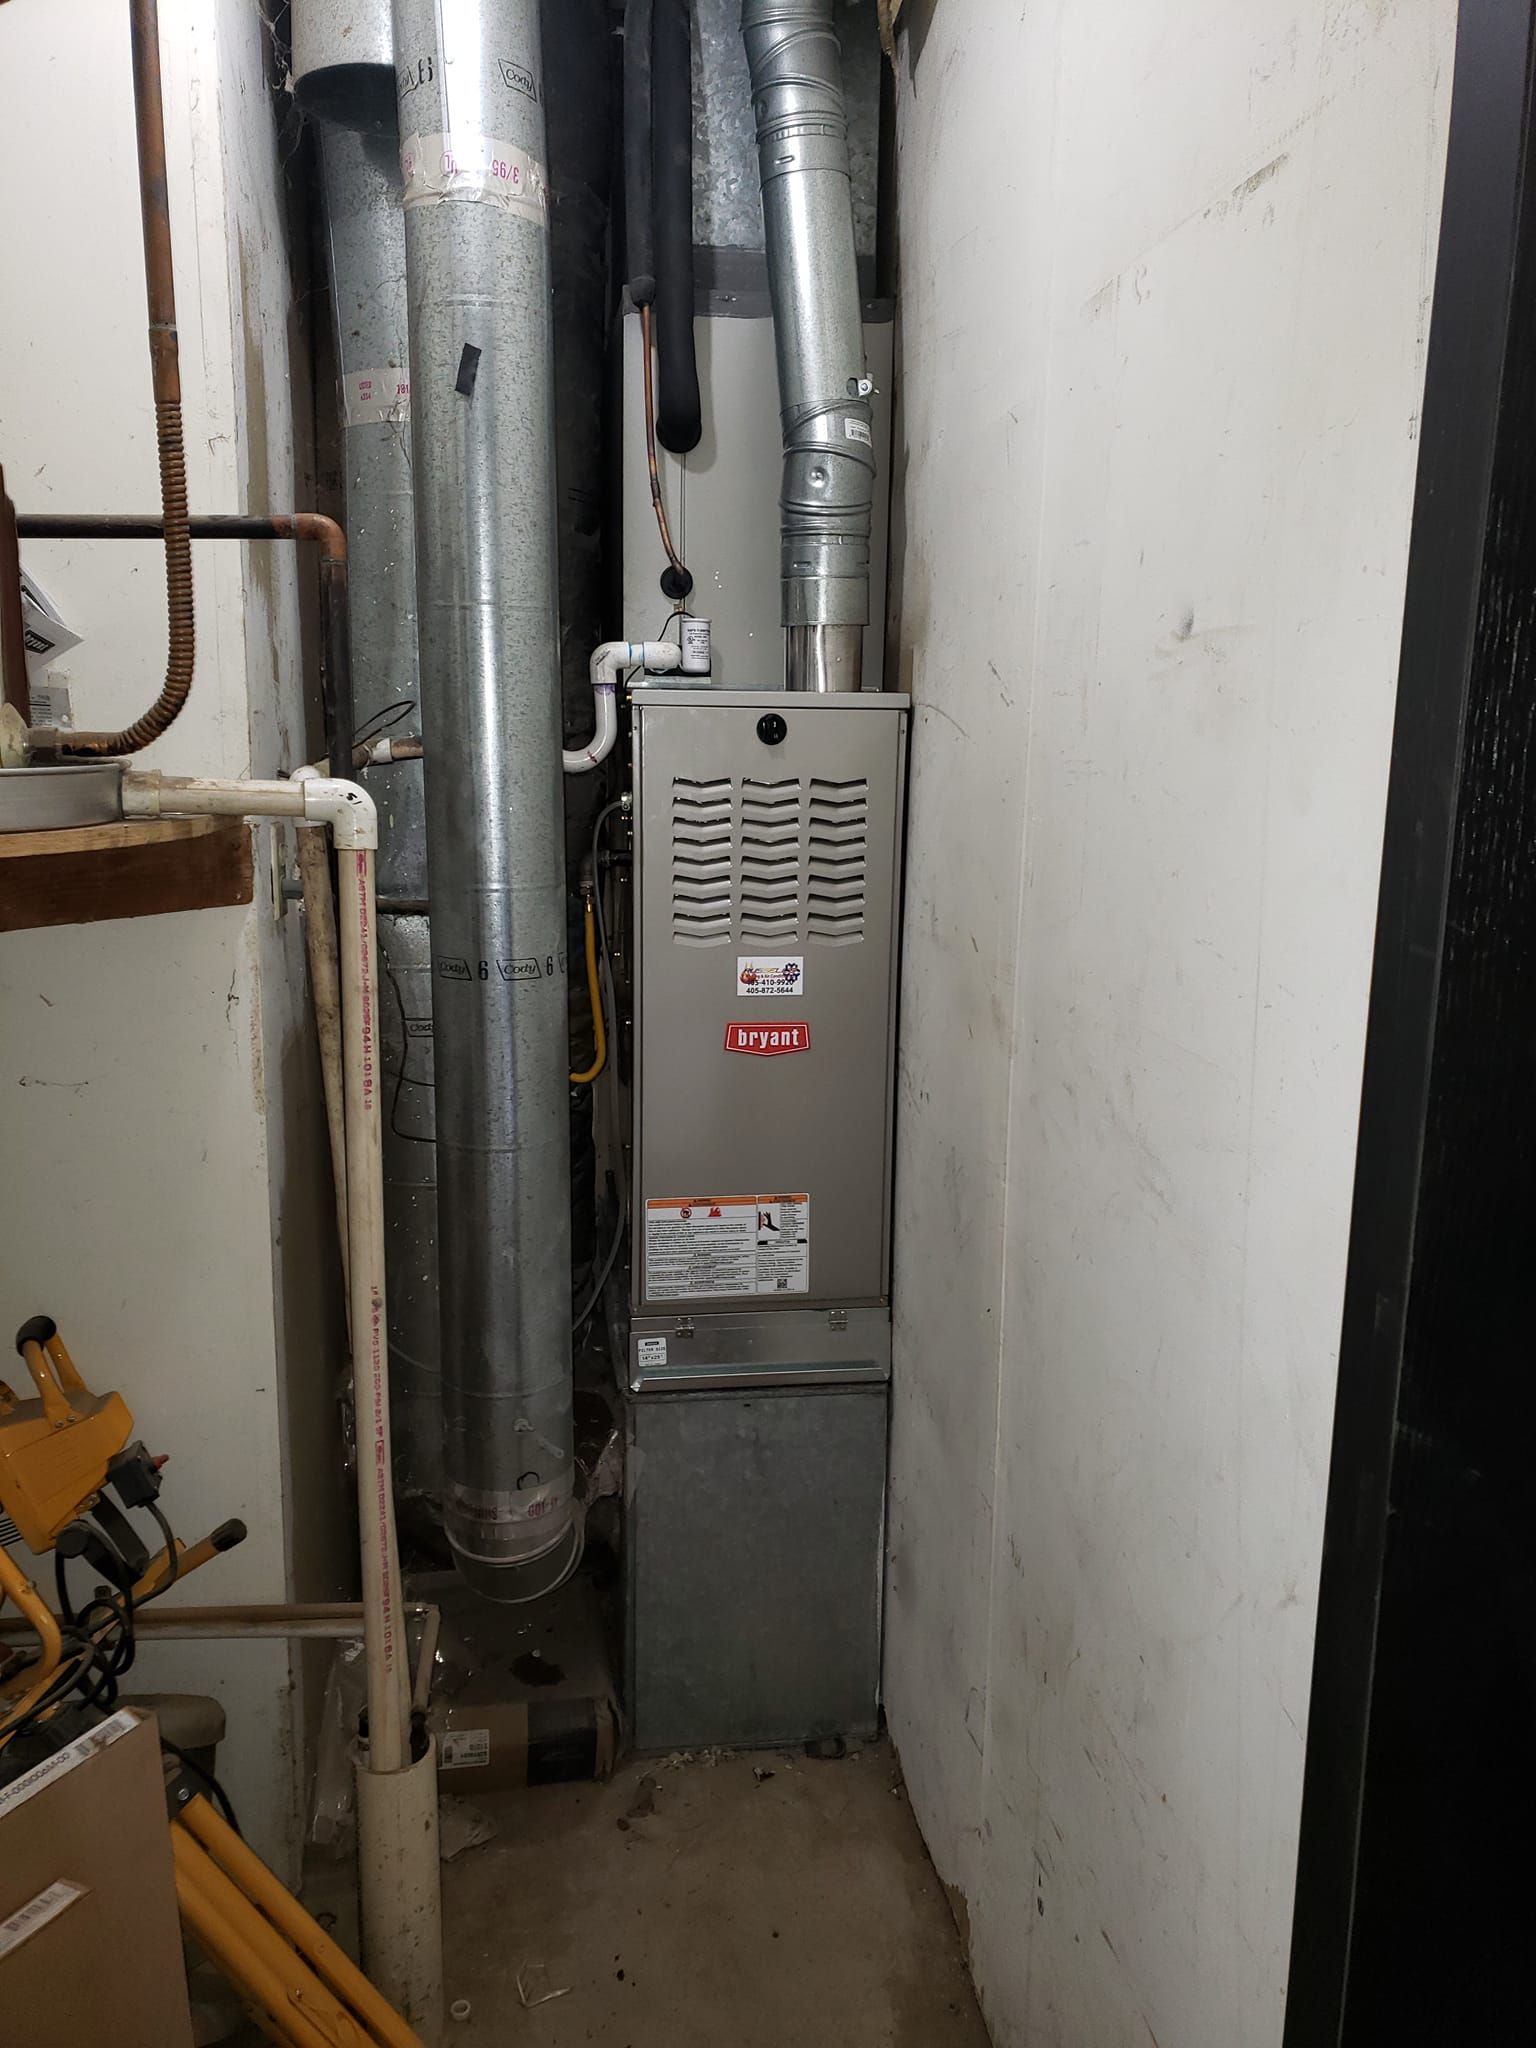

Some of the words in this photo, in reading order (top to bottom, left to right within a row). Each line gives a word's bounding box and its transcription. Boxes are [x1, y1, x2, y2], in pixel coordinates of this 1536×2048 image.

[478, 960, 489, 981] 6
[503, 963, 537, 975] Cody
[546, 955, 554, 976] 6
[737, 1029, 800, 1049] bryant
